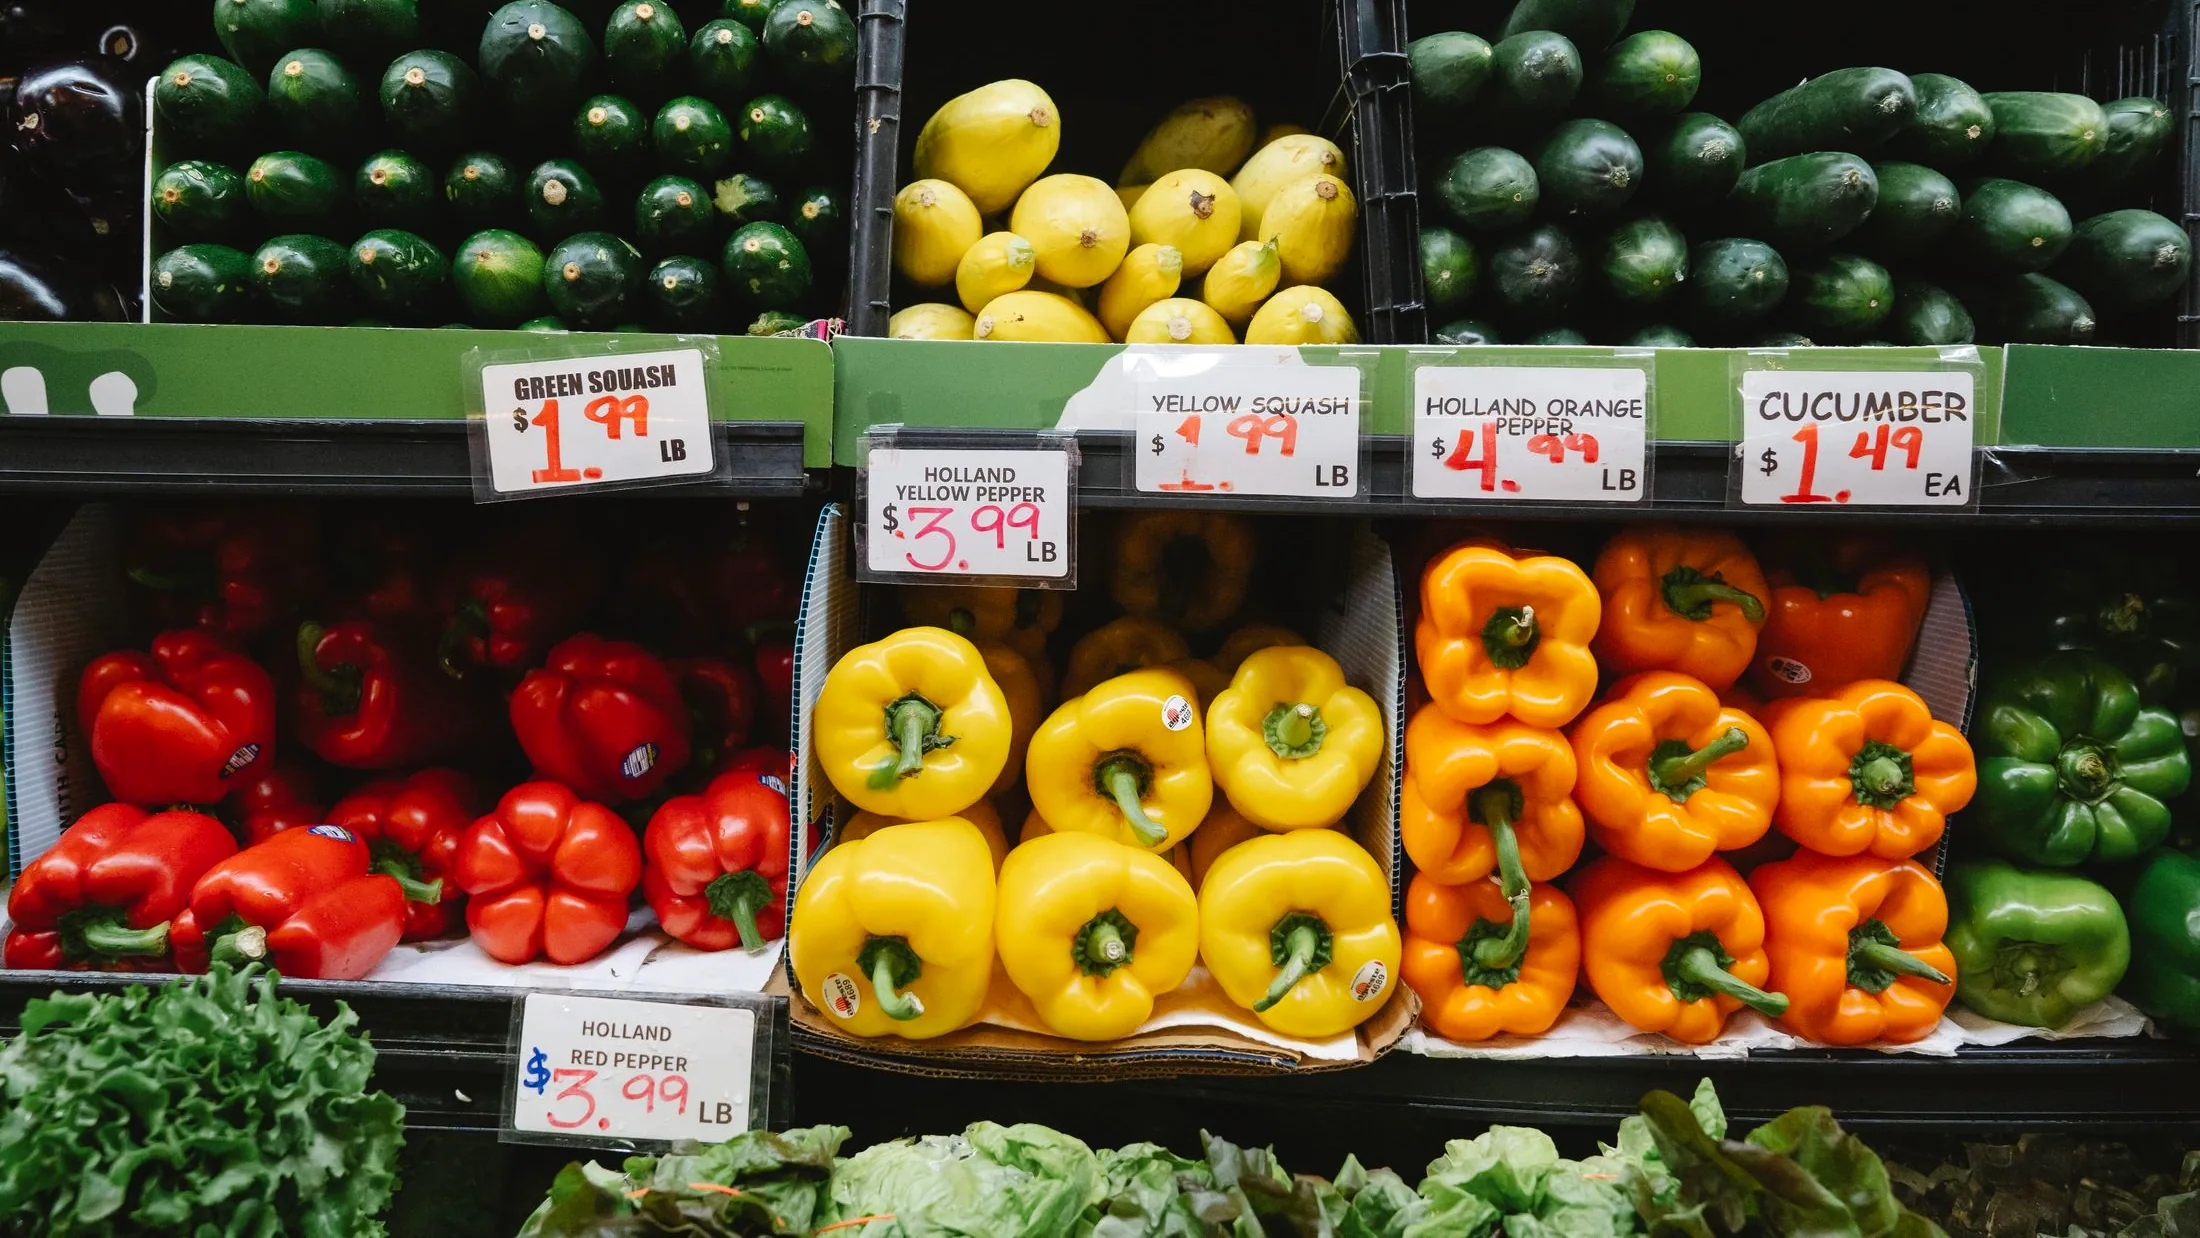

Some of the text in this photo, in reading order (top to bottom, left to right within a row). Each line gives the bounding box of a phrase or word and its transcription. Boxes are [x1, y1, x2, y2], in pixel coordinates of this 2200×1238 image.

[514, 364, 676, 400] GREEN SQUASH
[1152, 394, 1349, 418] YELLOW SQUASH
[1427, 397, 1643, 418] HOLLAND ORANGE
[1759, 390, 1967, 423] CUCUMBER
[1496, 417, 1573, 436] PEPPER
[660, 438, 687, 463] LB
[924, 467, 1016, 483] HOLLAND
[1315, 464, 1349, 487] LB
[1602, 468, 1636, 491] LB
[1924, 472, 1962, 497] EA
[896, 484, 1046, 502] YELLOW PEPPER
[1026, 541, 1057, 562] LB
[842, 979, 856, 1000] 4689
[1371, 974, 1385, 994] 4689
[582, 1020, 671, 1042] HOLLAND
[571, 1049, 688, 1072] RED PEPPER
[699, 1101, 733, 1125] LB
